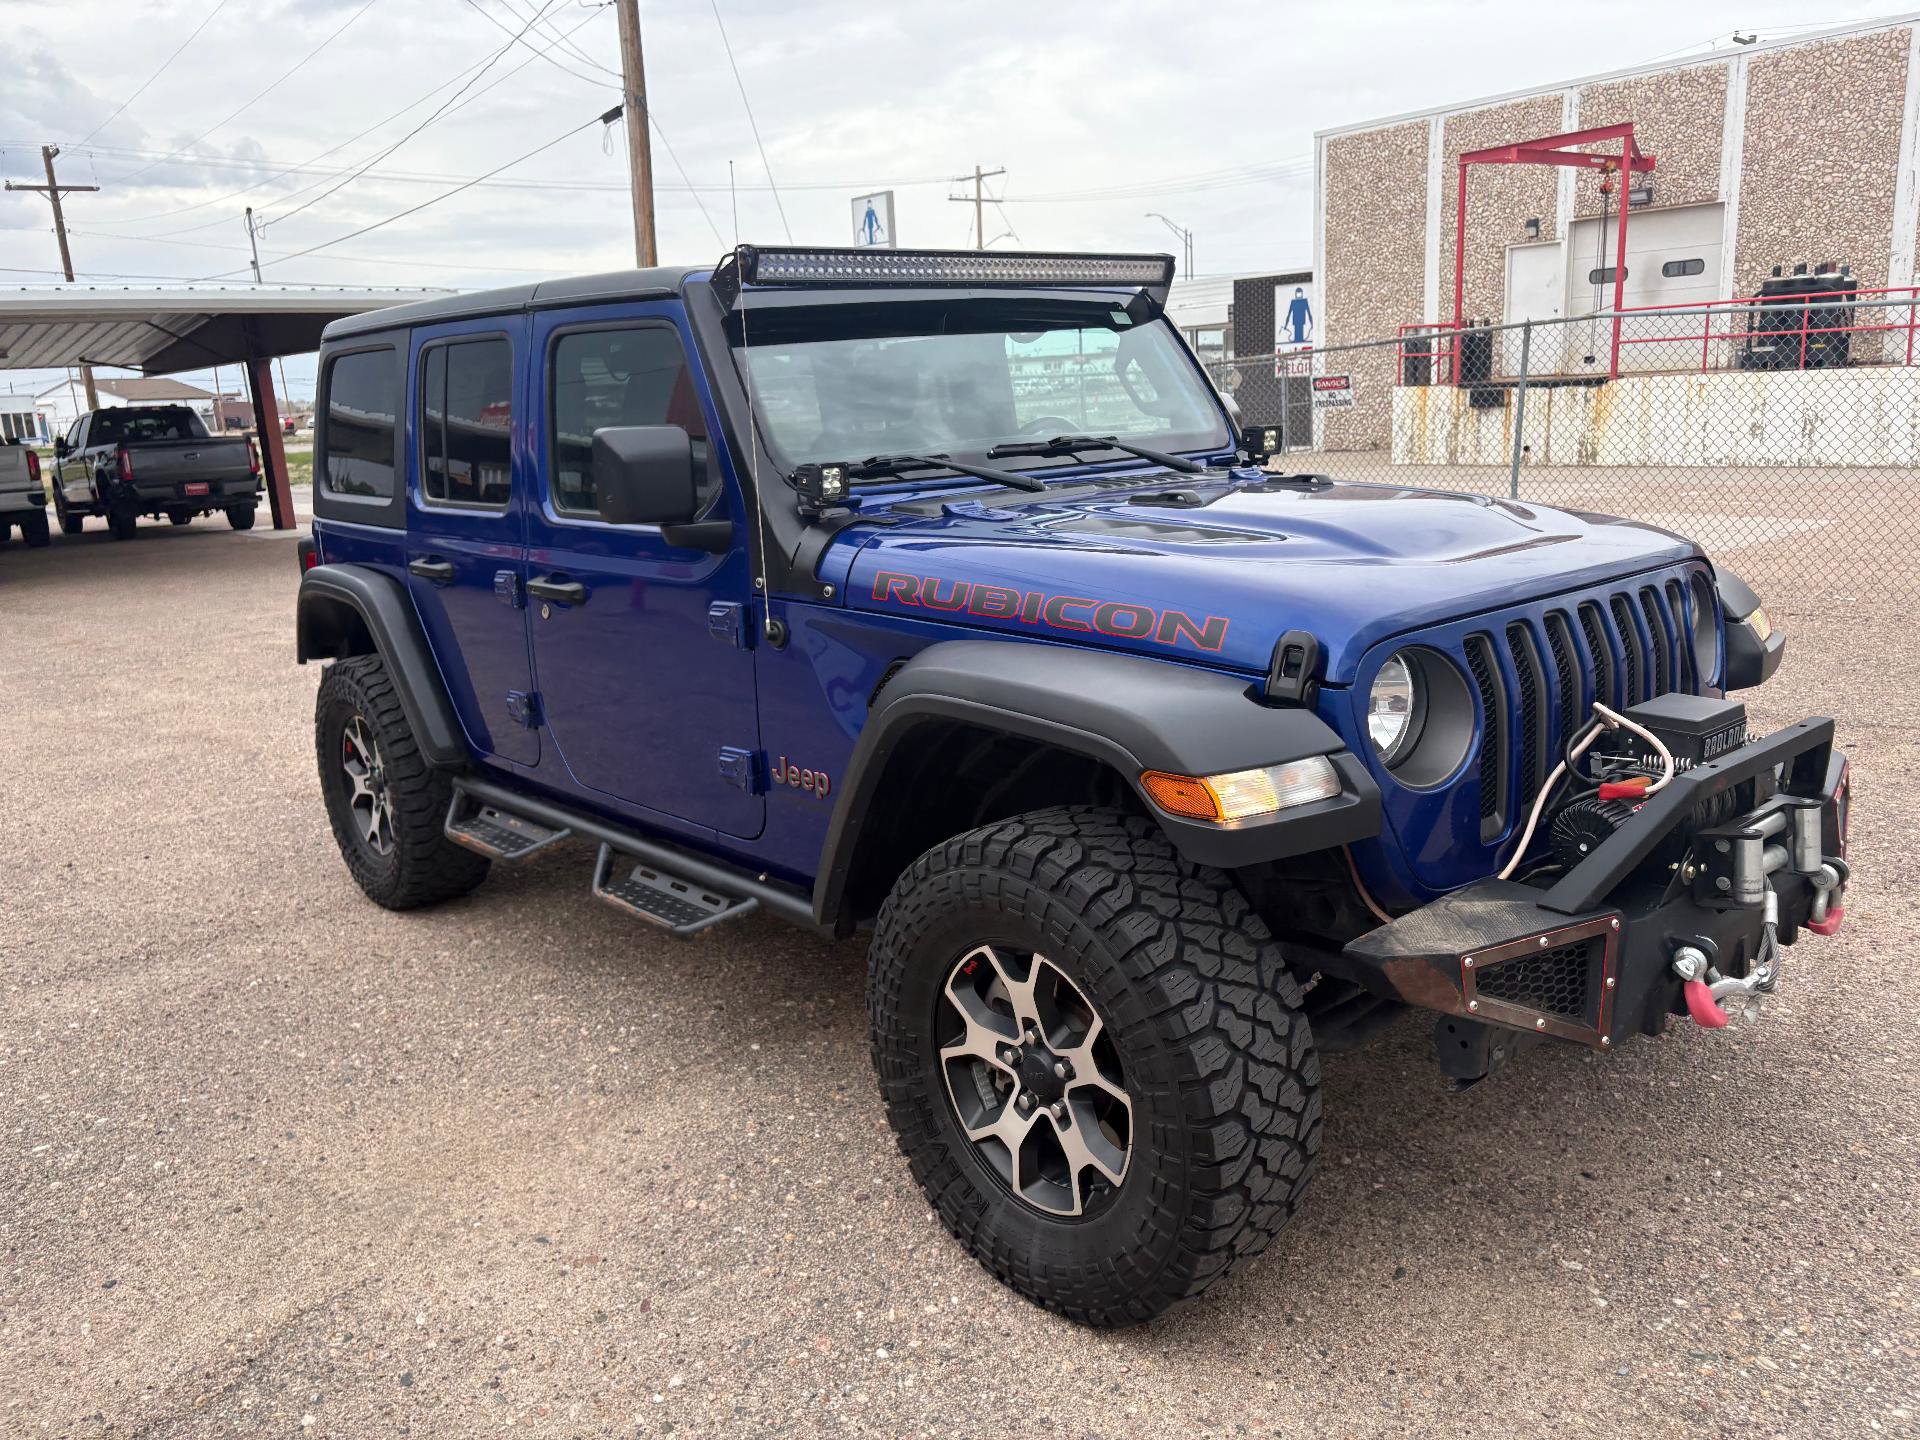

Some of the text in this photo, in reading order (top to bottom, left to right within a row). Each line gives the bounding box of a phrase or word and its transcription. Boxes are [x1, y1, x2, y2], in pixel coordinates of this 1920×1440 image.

[1315, 379, 1346, 389] DANGER
[1328, 391, 1337, 399] NO
[872, 570, 1230, 652] RUBICON
[771, 756, 831, 800] Jeep
